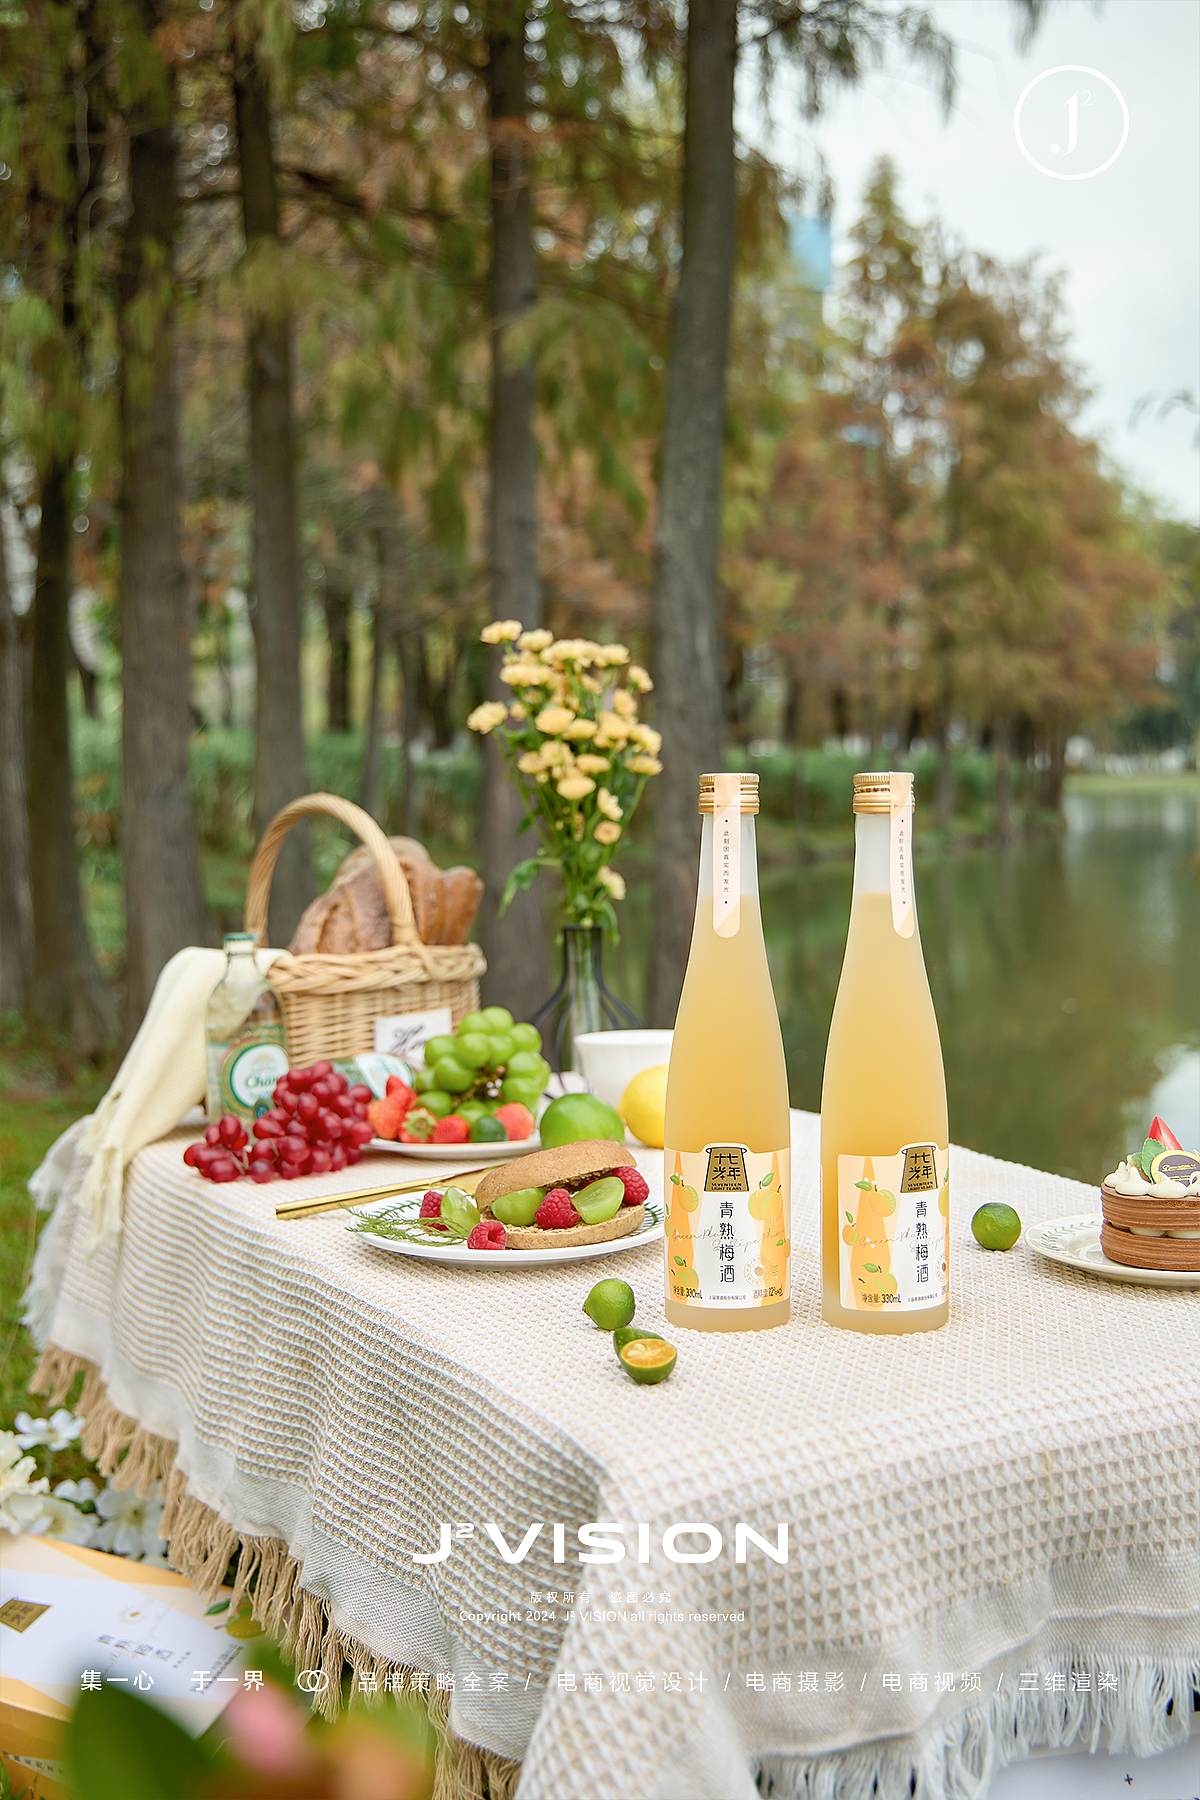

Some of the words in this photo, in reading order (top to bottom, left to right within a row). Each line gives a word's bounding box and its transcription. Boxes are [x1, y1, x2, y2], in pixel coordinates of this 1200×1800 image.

[713, 1152, 739, 1165] 十七
[909, 1151, 931, 1165] 十七
[719, 1200, 735, 1283] 青熟梅酒
[915, 1200, 929, 1283] 青熟梅酒
[881, 1293, 902, 1304] 330mL
